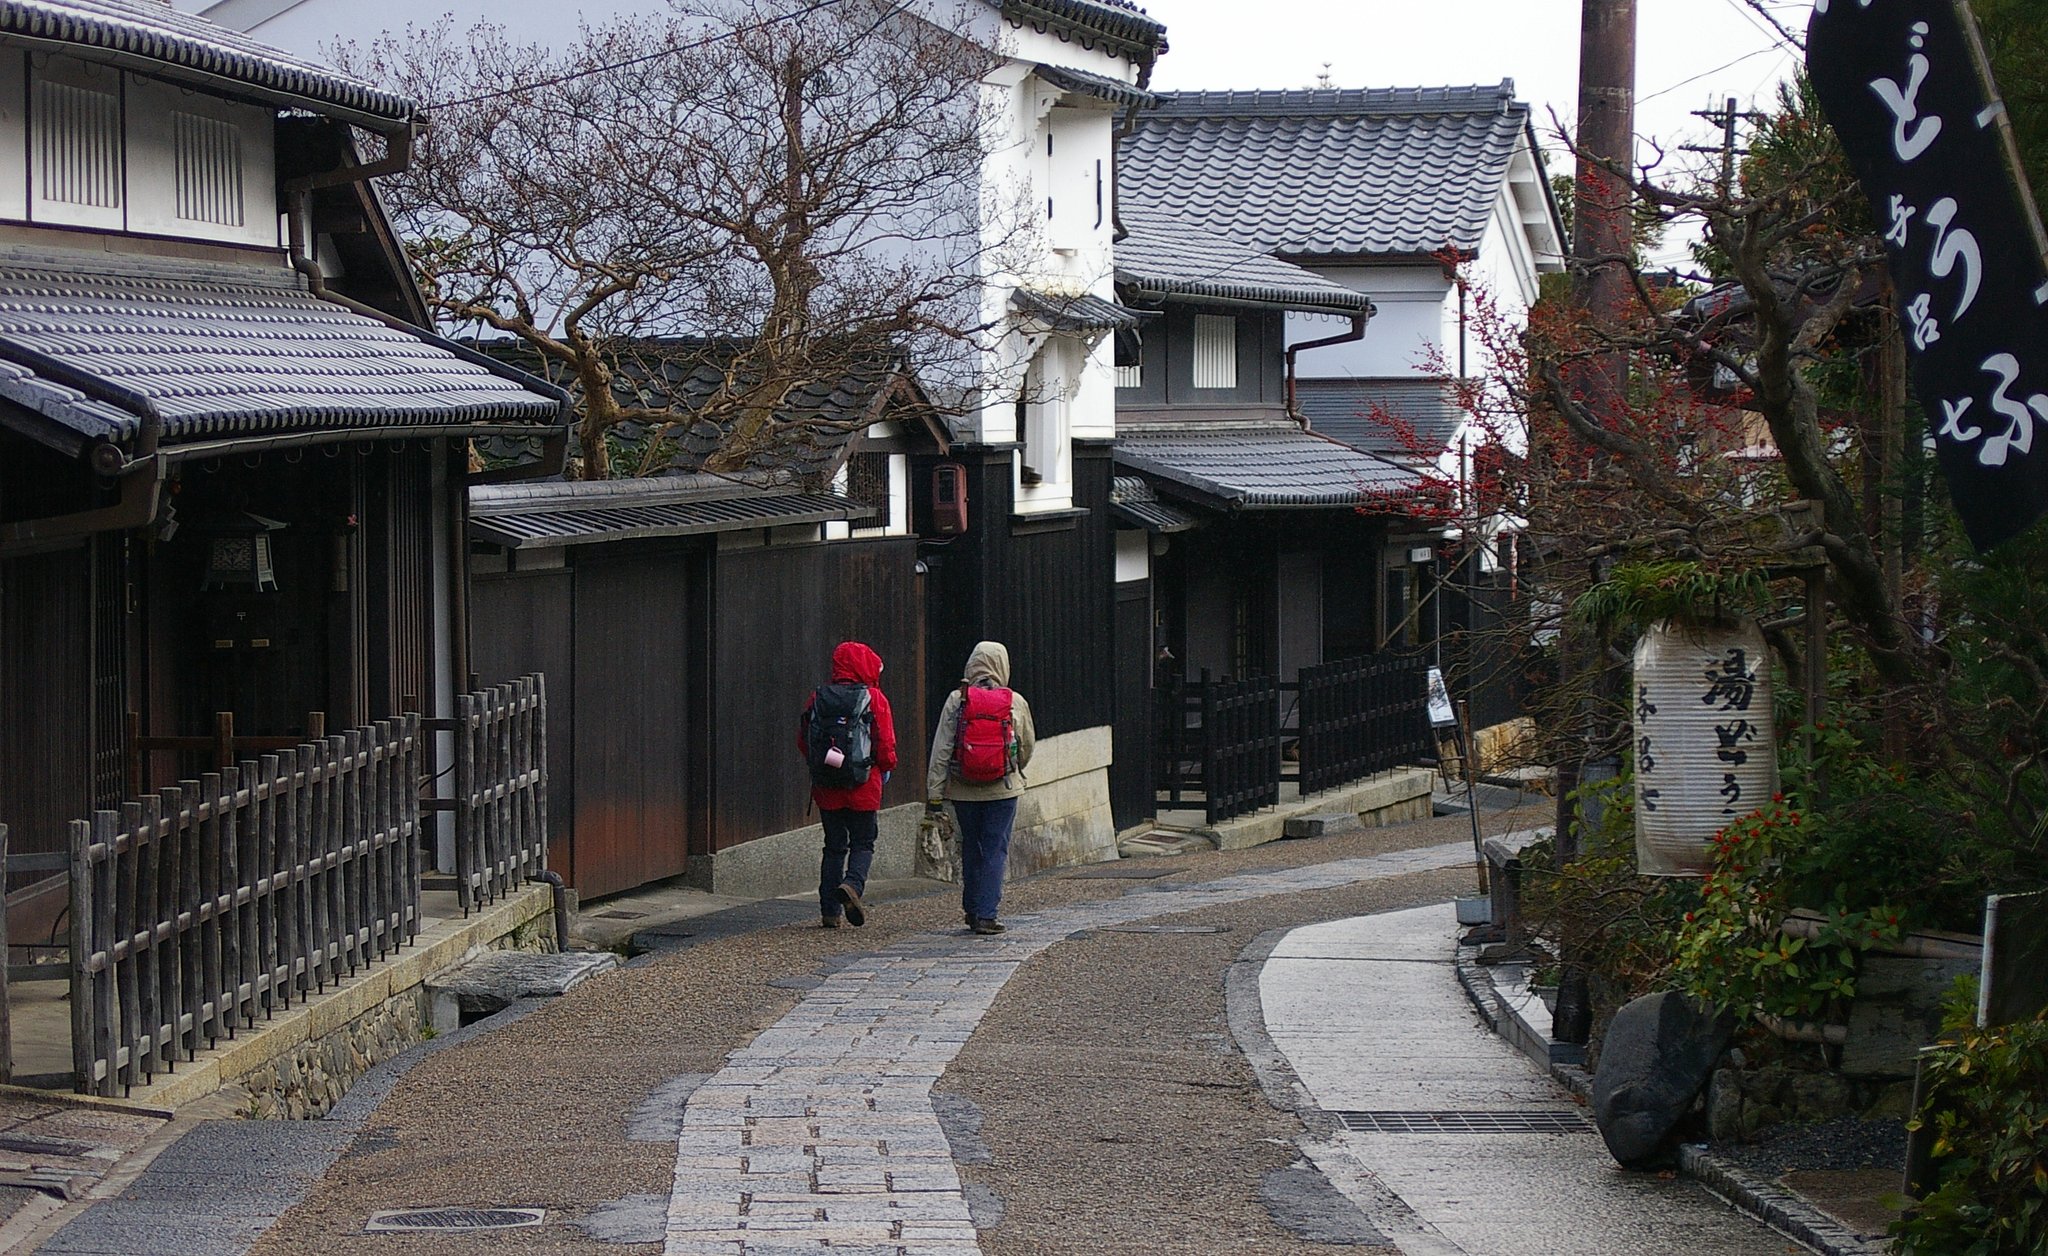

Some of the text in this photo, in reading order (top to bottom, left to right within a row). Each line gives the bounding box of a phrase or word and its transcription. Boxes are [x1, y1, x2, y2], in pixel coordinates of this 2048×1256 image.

[1815, 0, 2048, 466] どうふ
[1702, 648, 1758, 842] 湯どう
